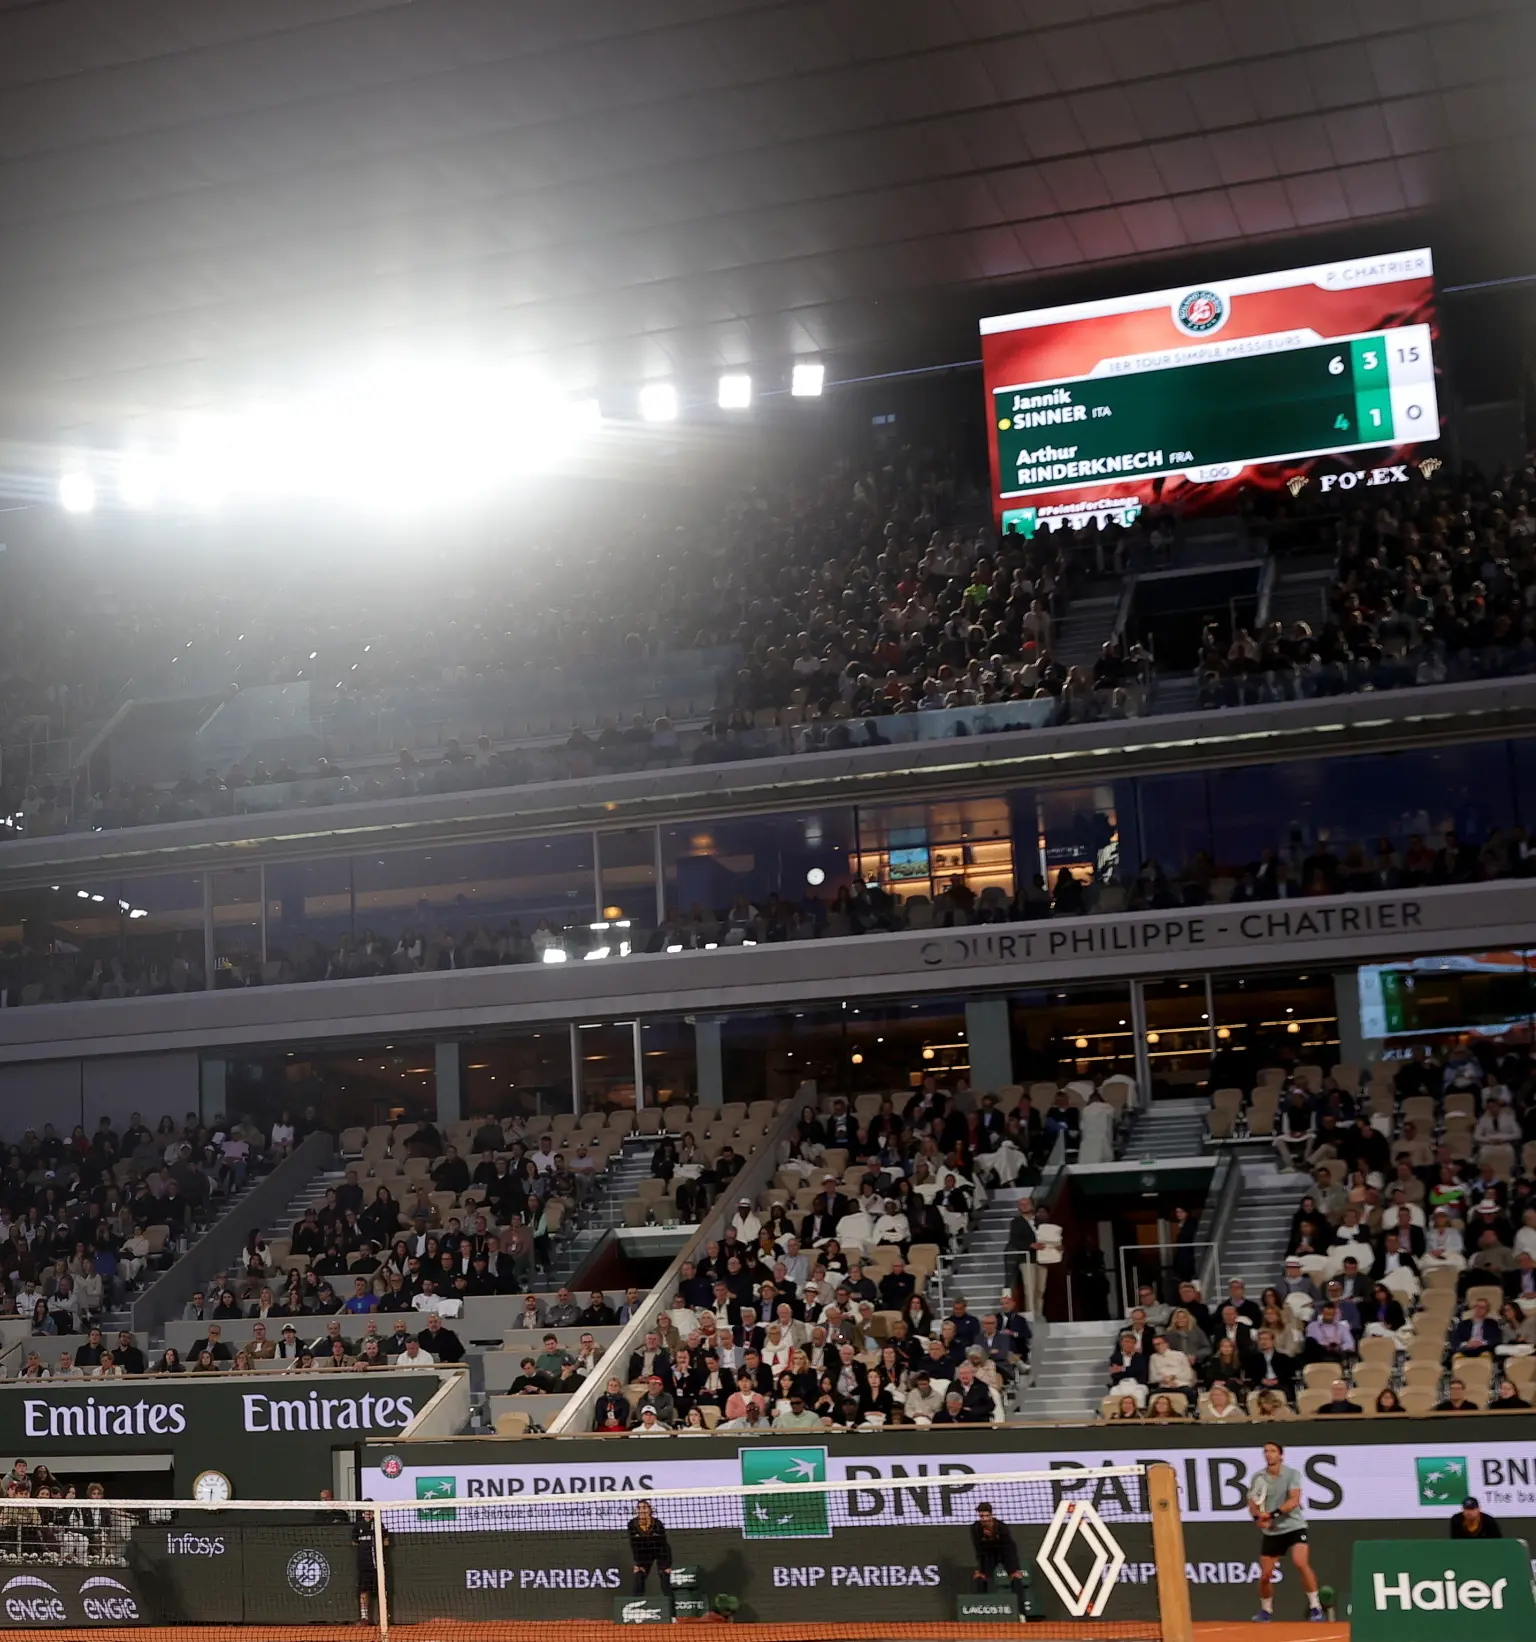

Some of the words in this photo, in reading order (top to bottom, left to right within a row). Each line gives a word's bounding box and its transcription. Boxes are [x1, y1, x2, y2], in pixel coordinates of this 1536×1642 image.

[1342, 258, 1424, 281] CHATRIER
[1328, 355, 1345, 375] 6
[1361, 350, 1379, 371] 3
[1397, 346, 1420, 364] 15
[1012, 387, 1072, 411] Jannik
[1013, 404, 1088, 430] SINNER
[1091, 405, 1113, 419] ITA
[1333, 412, 1351, 431] 4
[1368, 407, 1382, 428] 1
[1016, 444, 1078, 466] Arthur
[1017, 449, 1164, 485] RINDERKNECH
[1168, 449, 1195, 465] FRA
[919, 931, 1036, 966] COURT
[1050, 919, 1206, 956] PHILIPPE
[1239, 900, 1423, 939] CHATRIER
[24, 1397, 187, 1437] Emirates
[242, 1391, 416, 1433] Emirates
[1482, 1458, 1536, 1487] BN
[845, 1463, 976, 1517] BNP
[1050, 1454, 1344, 1514] PAIBS
[1485, 1491, 1512, 1503] The
[167, 1533, 225, 1557] Infosys
[465, 1569, 514, 1589] BNP
[520, 1567, 621, 1589] PARIBAS
[772, 1566, 825, 1588] BNP
[830, 1565, 941, 1587] PARIBAS
[1185, 1561, 1284, 1584] ARIBAS
[1373, 1569, 1508, 1611] Haier
[962, 1604, 1012, 1615] LACOSTE
